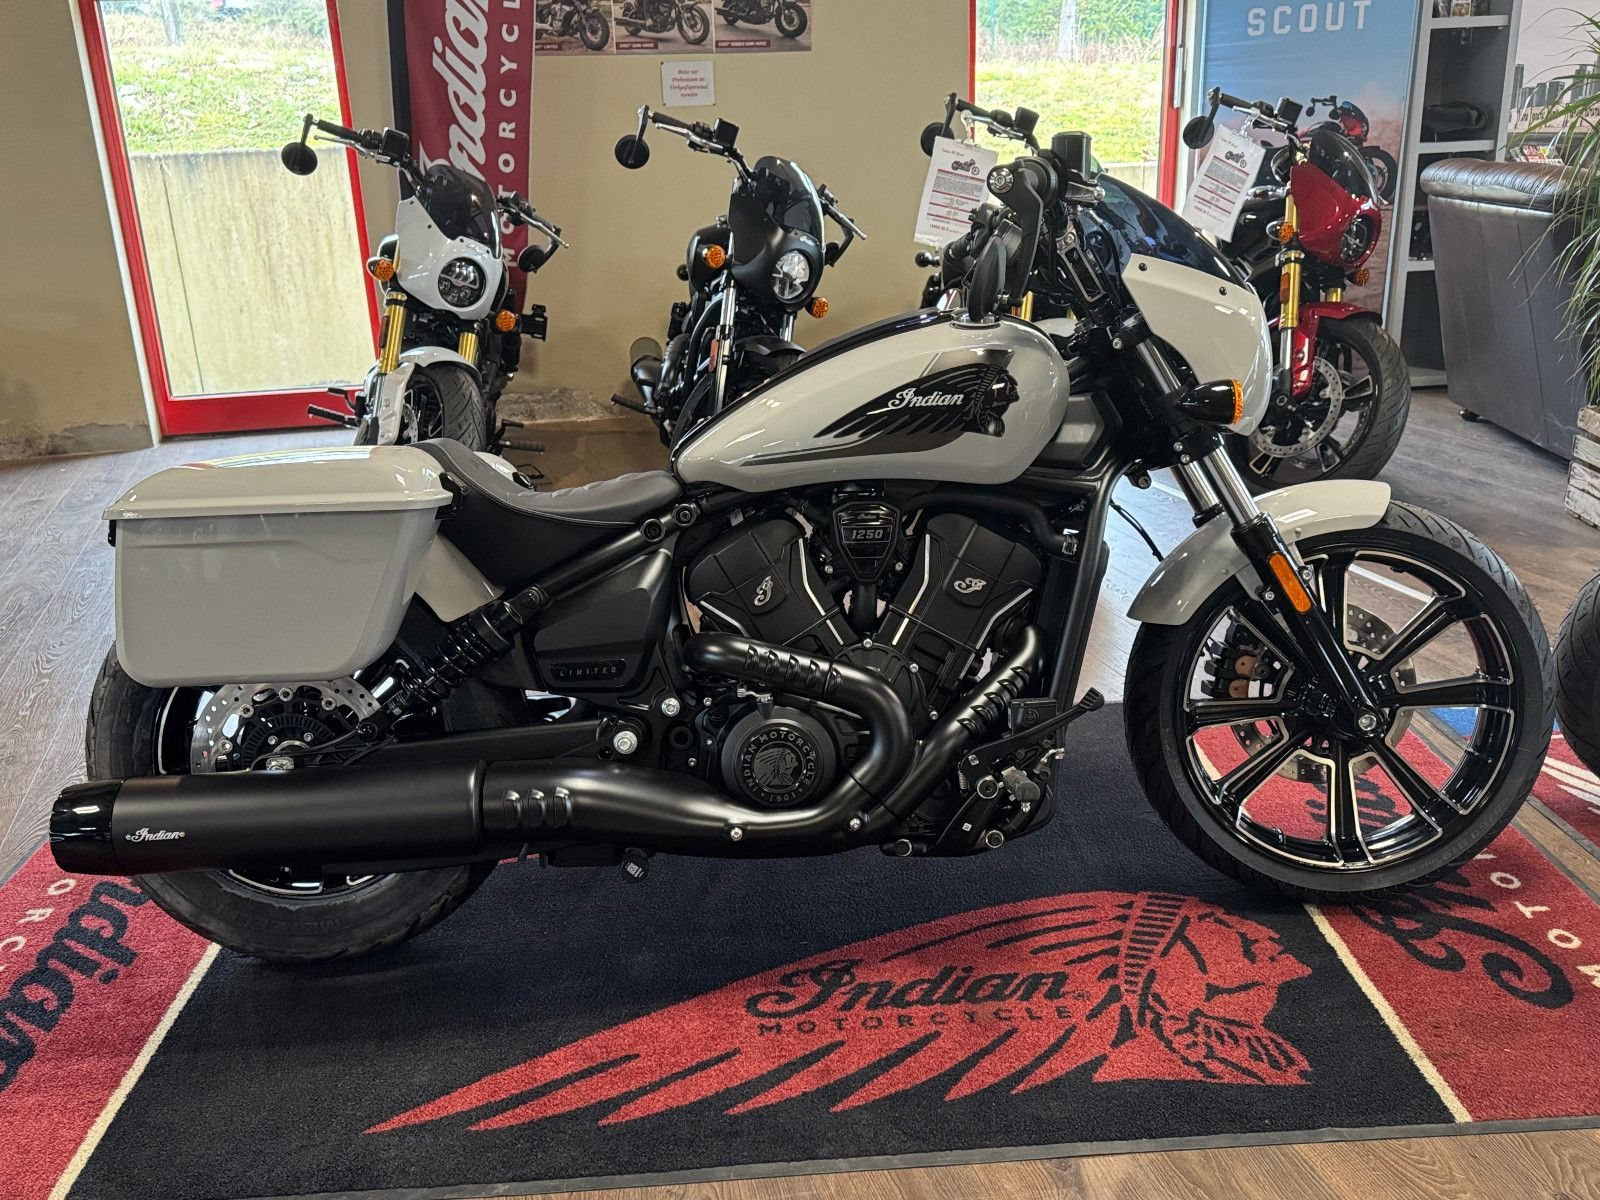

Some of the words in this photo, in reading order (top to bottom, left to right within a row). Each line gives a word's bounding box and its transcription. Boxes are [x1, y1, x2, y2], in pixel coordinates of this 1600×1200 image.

[1247, 0, 1372, 36] SCOUT
[419, 0, 490, 182] ndia
[888, 387, 965, 410] Indian
[852, 529, 884, 540] 1250
[559, 666, 617, 677] LIMITED
[742, 743, 759, 792] INDIAN
[759, 731, 817, 786] MOTORCYCLE
[130, 827, 181, 843] Indian
[744, 957, 1070, 1020] Indian
[758, 1004, 1073, 1036] MOTORCYCLE
